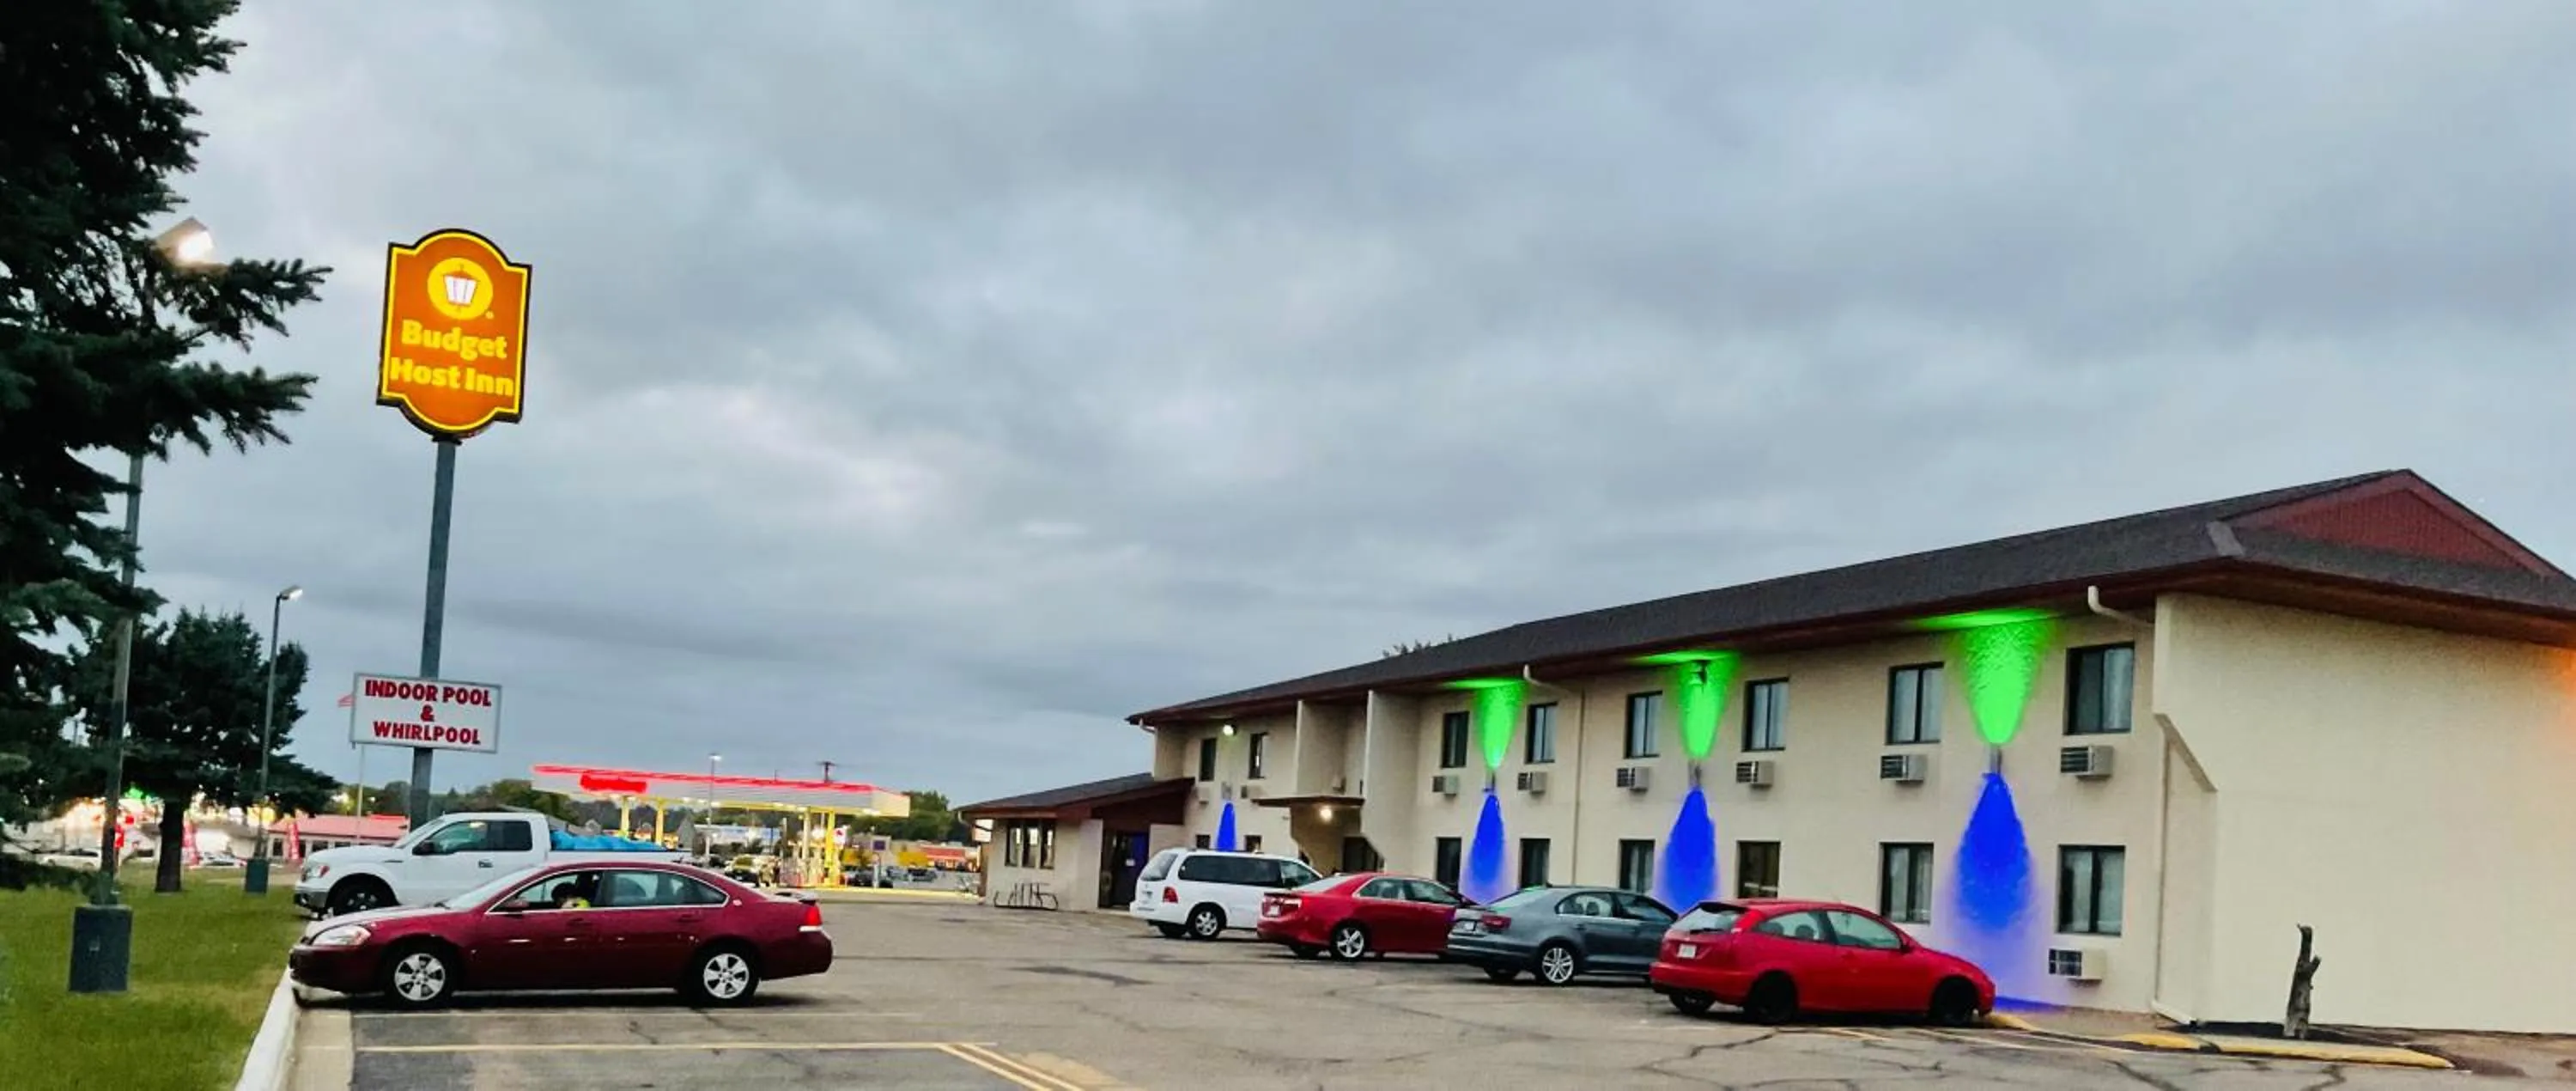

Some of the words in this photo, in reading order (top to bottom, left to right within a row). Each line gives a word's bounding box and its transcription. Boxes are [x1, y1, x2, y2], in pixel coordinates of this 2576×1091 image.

[402, 320, 507, 361] Budget
[389, 357, 461, 389] Host
[465, 367, 514, 397] Inn
[365, 680, 437, 702] INDOOR
[442, 687, 491, 706] POOL
[421, 704, 434, 722] &
[374, 721, 480, 744] WHIRLPOOL
